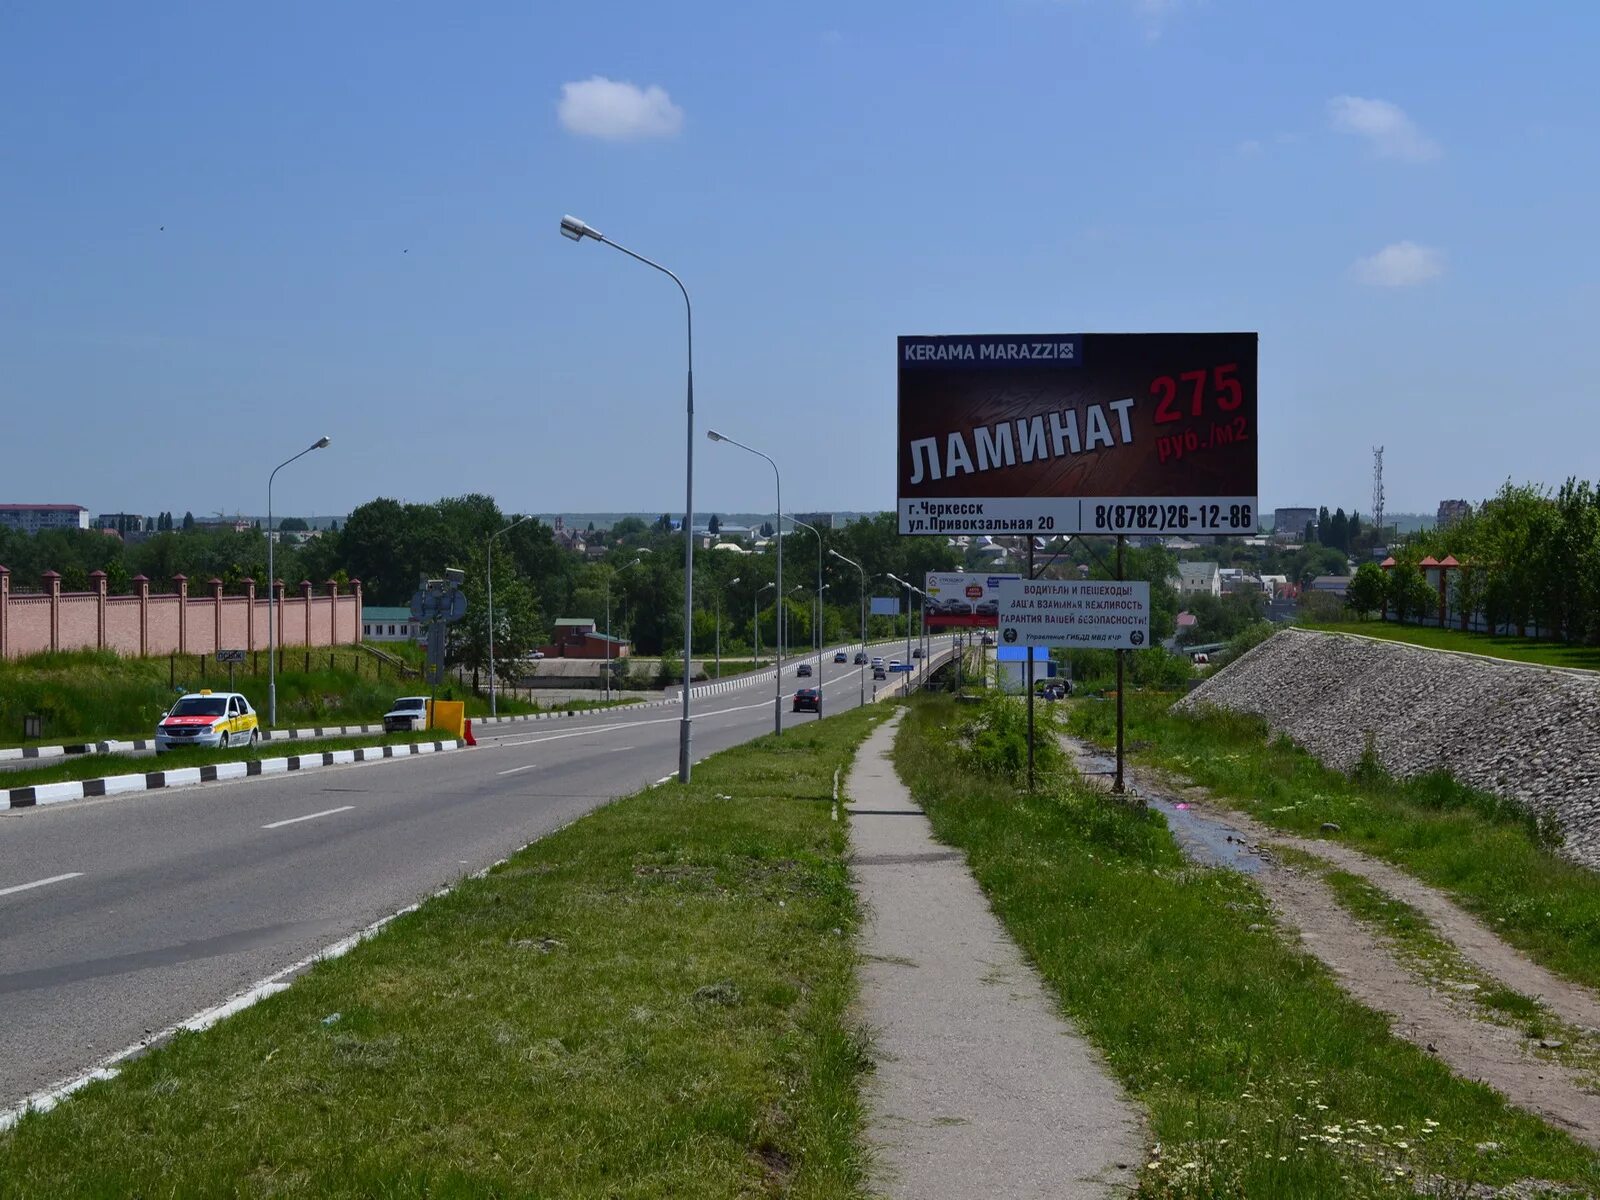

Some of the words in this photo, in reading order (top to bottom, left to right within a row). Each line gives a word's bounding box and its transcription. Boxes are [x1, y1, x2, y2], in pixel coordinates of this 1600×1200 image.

[904, 344, 975, 361] KERAMA
[980, 343, 1058, 360] MARAZZI
[1150, 363, 1243, 424] 275
[909, 397, 1135, 485] ЛАМИНАТ
[1155, 416, 1249, 464] руб./м2
[909, 502, 984, 516] г.Черкесск
[1095, 504, 1251, 531] 8(8782)26-12-86
[909, 517, 1034, 533] ул.Привокзальная
[1038, 516, 1054, 530] 20
[1024, 585, 1070, 596] ВОДИТЕЛИ
[1072, 586, 1078, 595] И
[1081, 586, 1133, 597] ПЕШЕХОДЫ!
[1085, 600, 1143, 610] ВЕЖЛИВОСТЬ
[1001, 614, 1042, 624] ГАРАНТИЯ
[1045, 613, 1075, 624] ВАШЕЙ
[1026, 633, 1065, 642] Управление
[1066, 633, 1090, 642] ГИБДД
[1091, 634, 1106, 642] МВД
